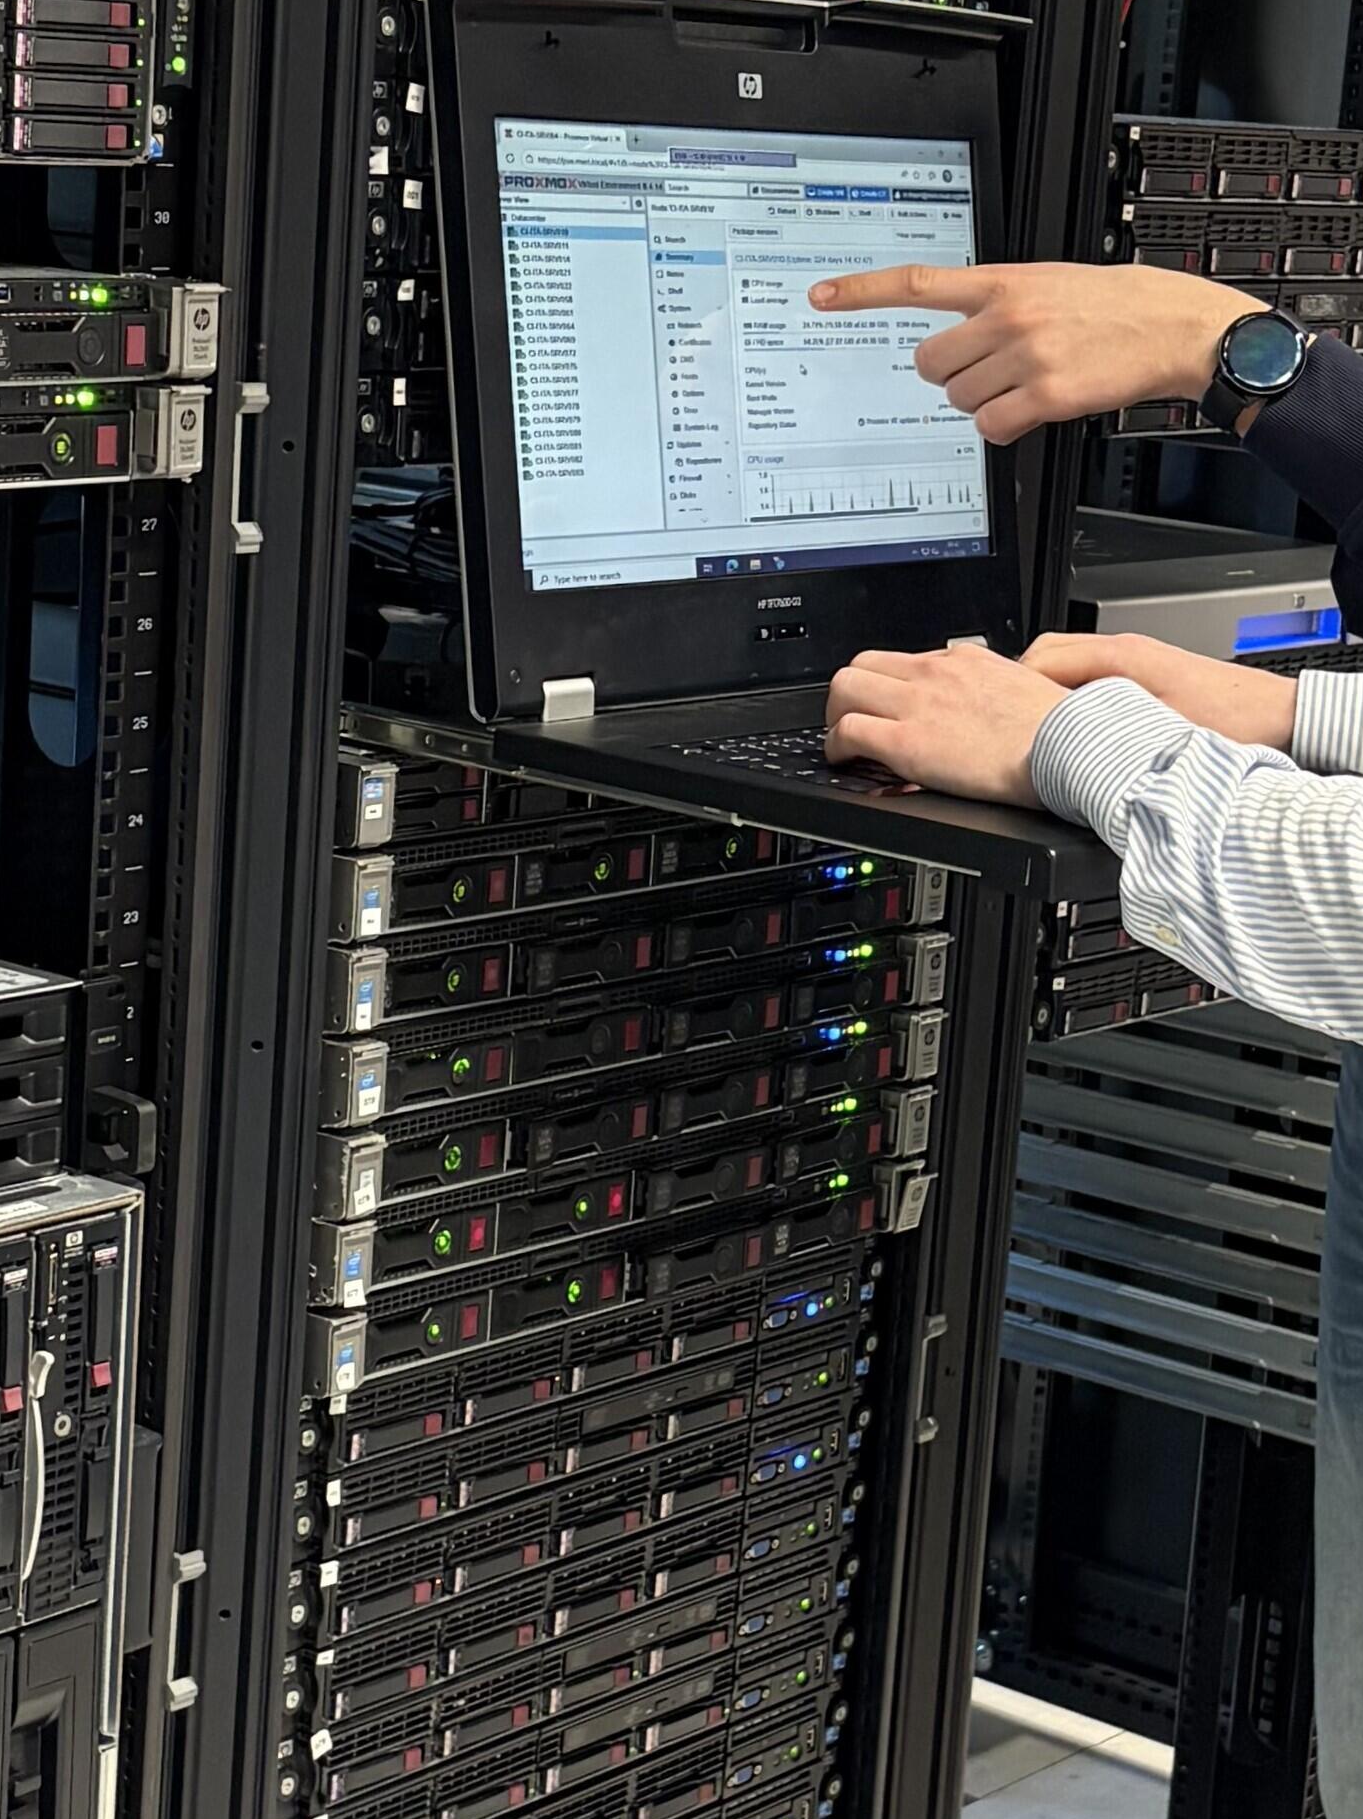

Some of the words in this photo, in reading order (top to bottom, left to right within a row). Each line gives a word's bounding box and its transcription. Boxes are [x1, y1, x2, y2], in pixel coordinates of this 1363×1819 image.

[504, 176, 576, 189] PROXMOX
[154, 211, 170, 224] 30
[141, 518, 158, 532] 27
[136, 618, 153, 632] 26
[132, 716, 148, 730] 25
[128, 814, 143, 828] 24
[123, 910, 139, 924] 23
